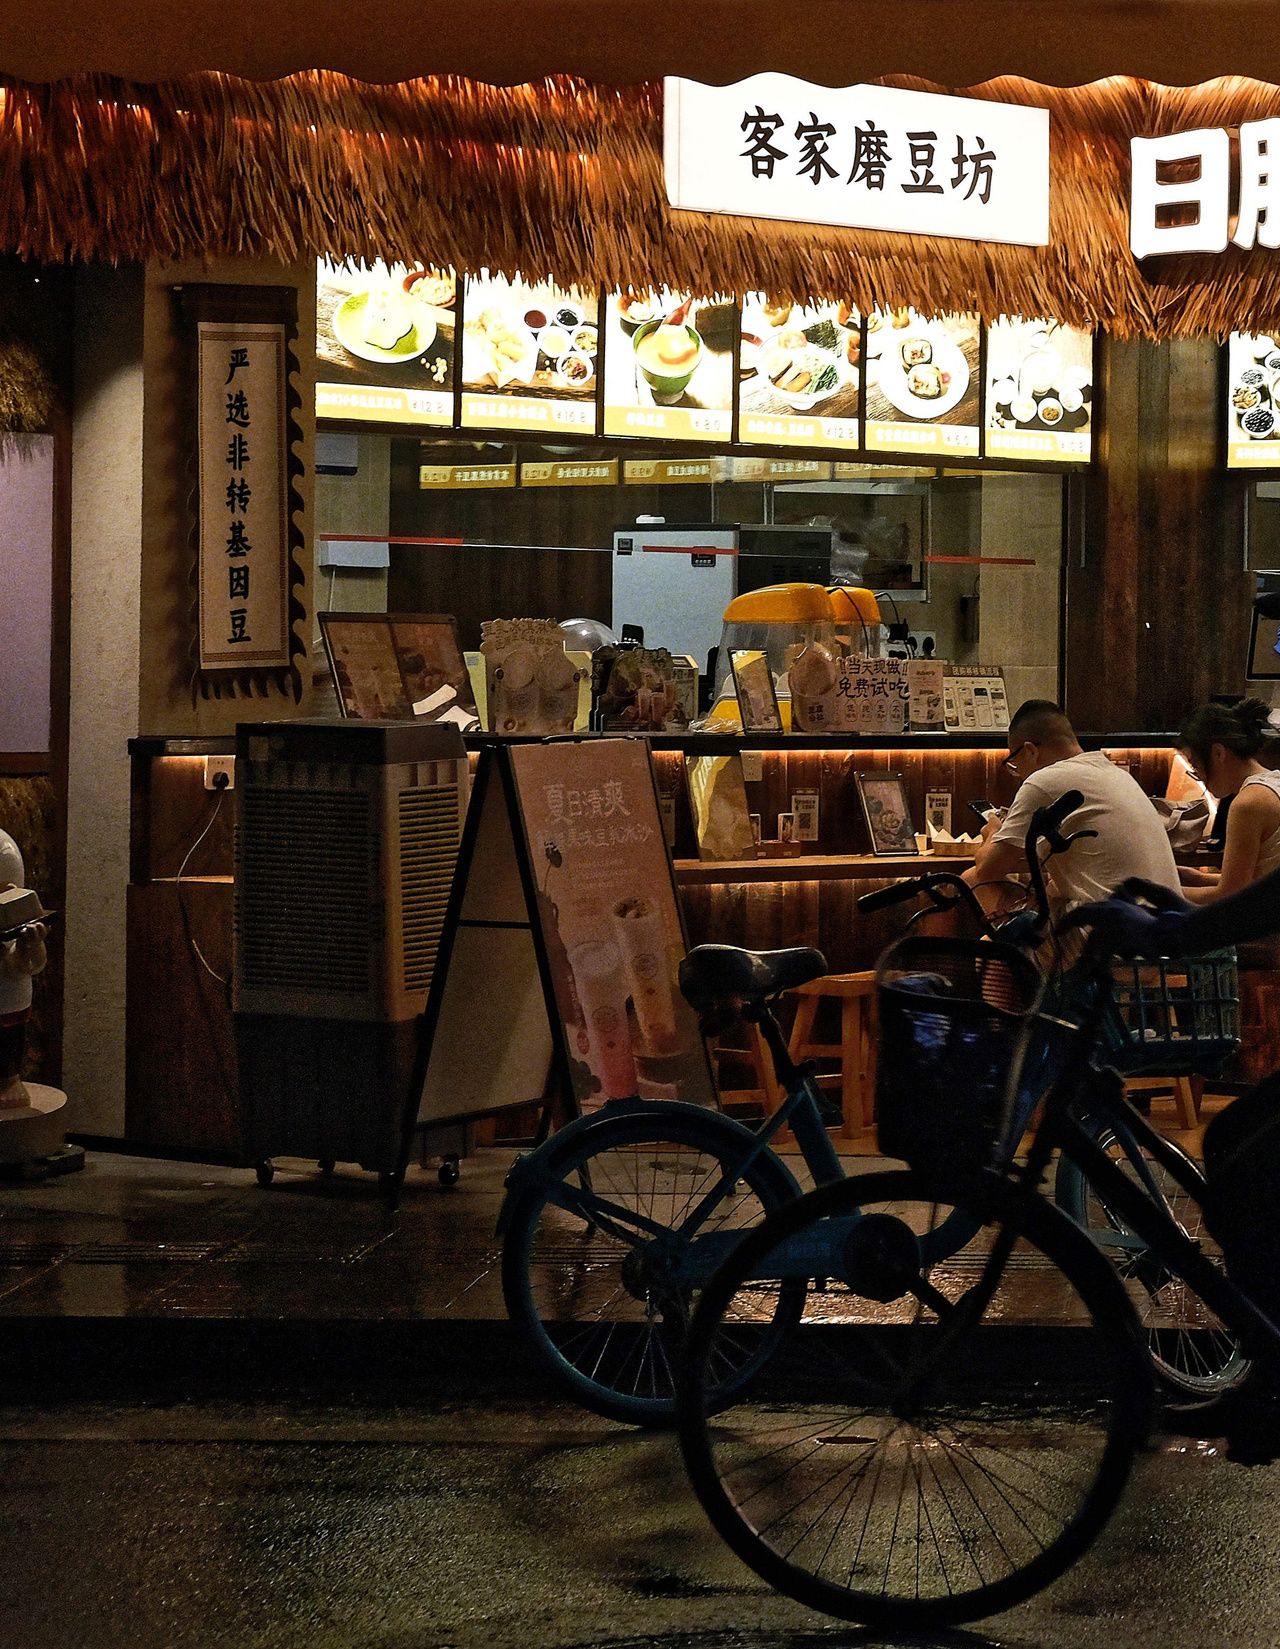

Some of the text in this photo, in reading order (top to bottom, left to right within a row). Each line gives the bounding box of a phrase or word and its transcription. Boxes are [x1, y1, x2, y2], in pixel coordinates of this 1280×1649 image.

[738, 105, 998, 206] 客家磨豆坊
[223, 347, 253, 645] 严选非转基因豆
[836, 676, 911, 700] 免费试吃
[542, 779, 631, 824] 夏日清爽
